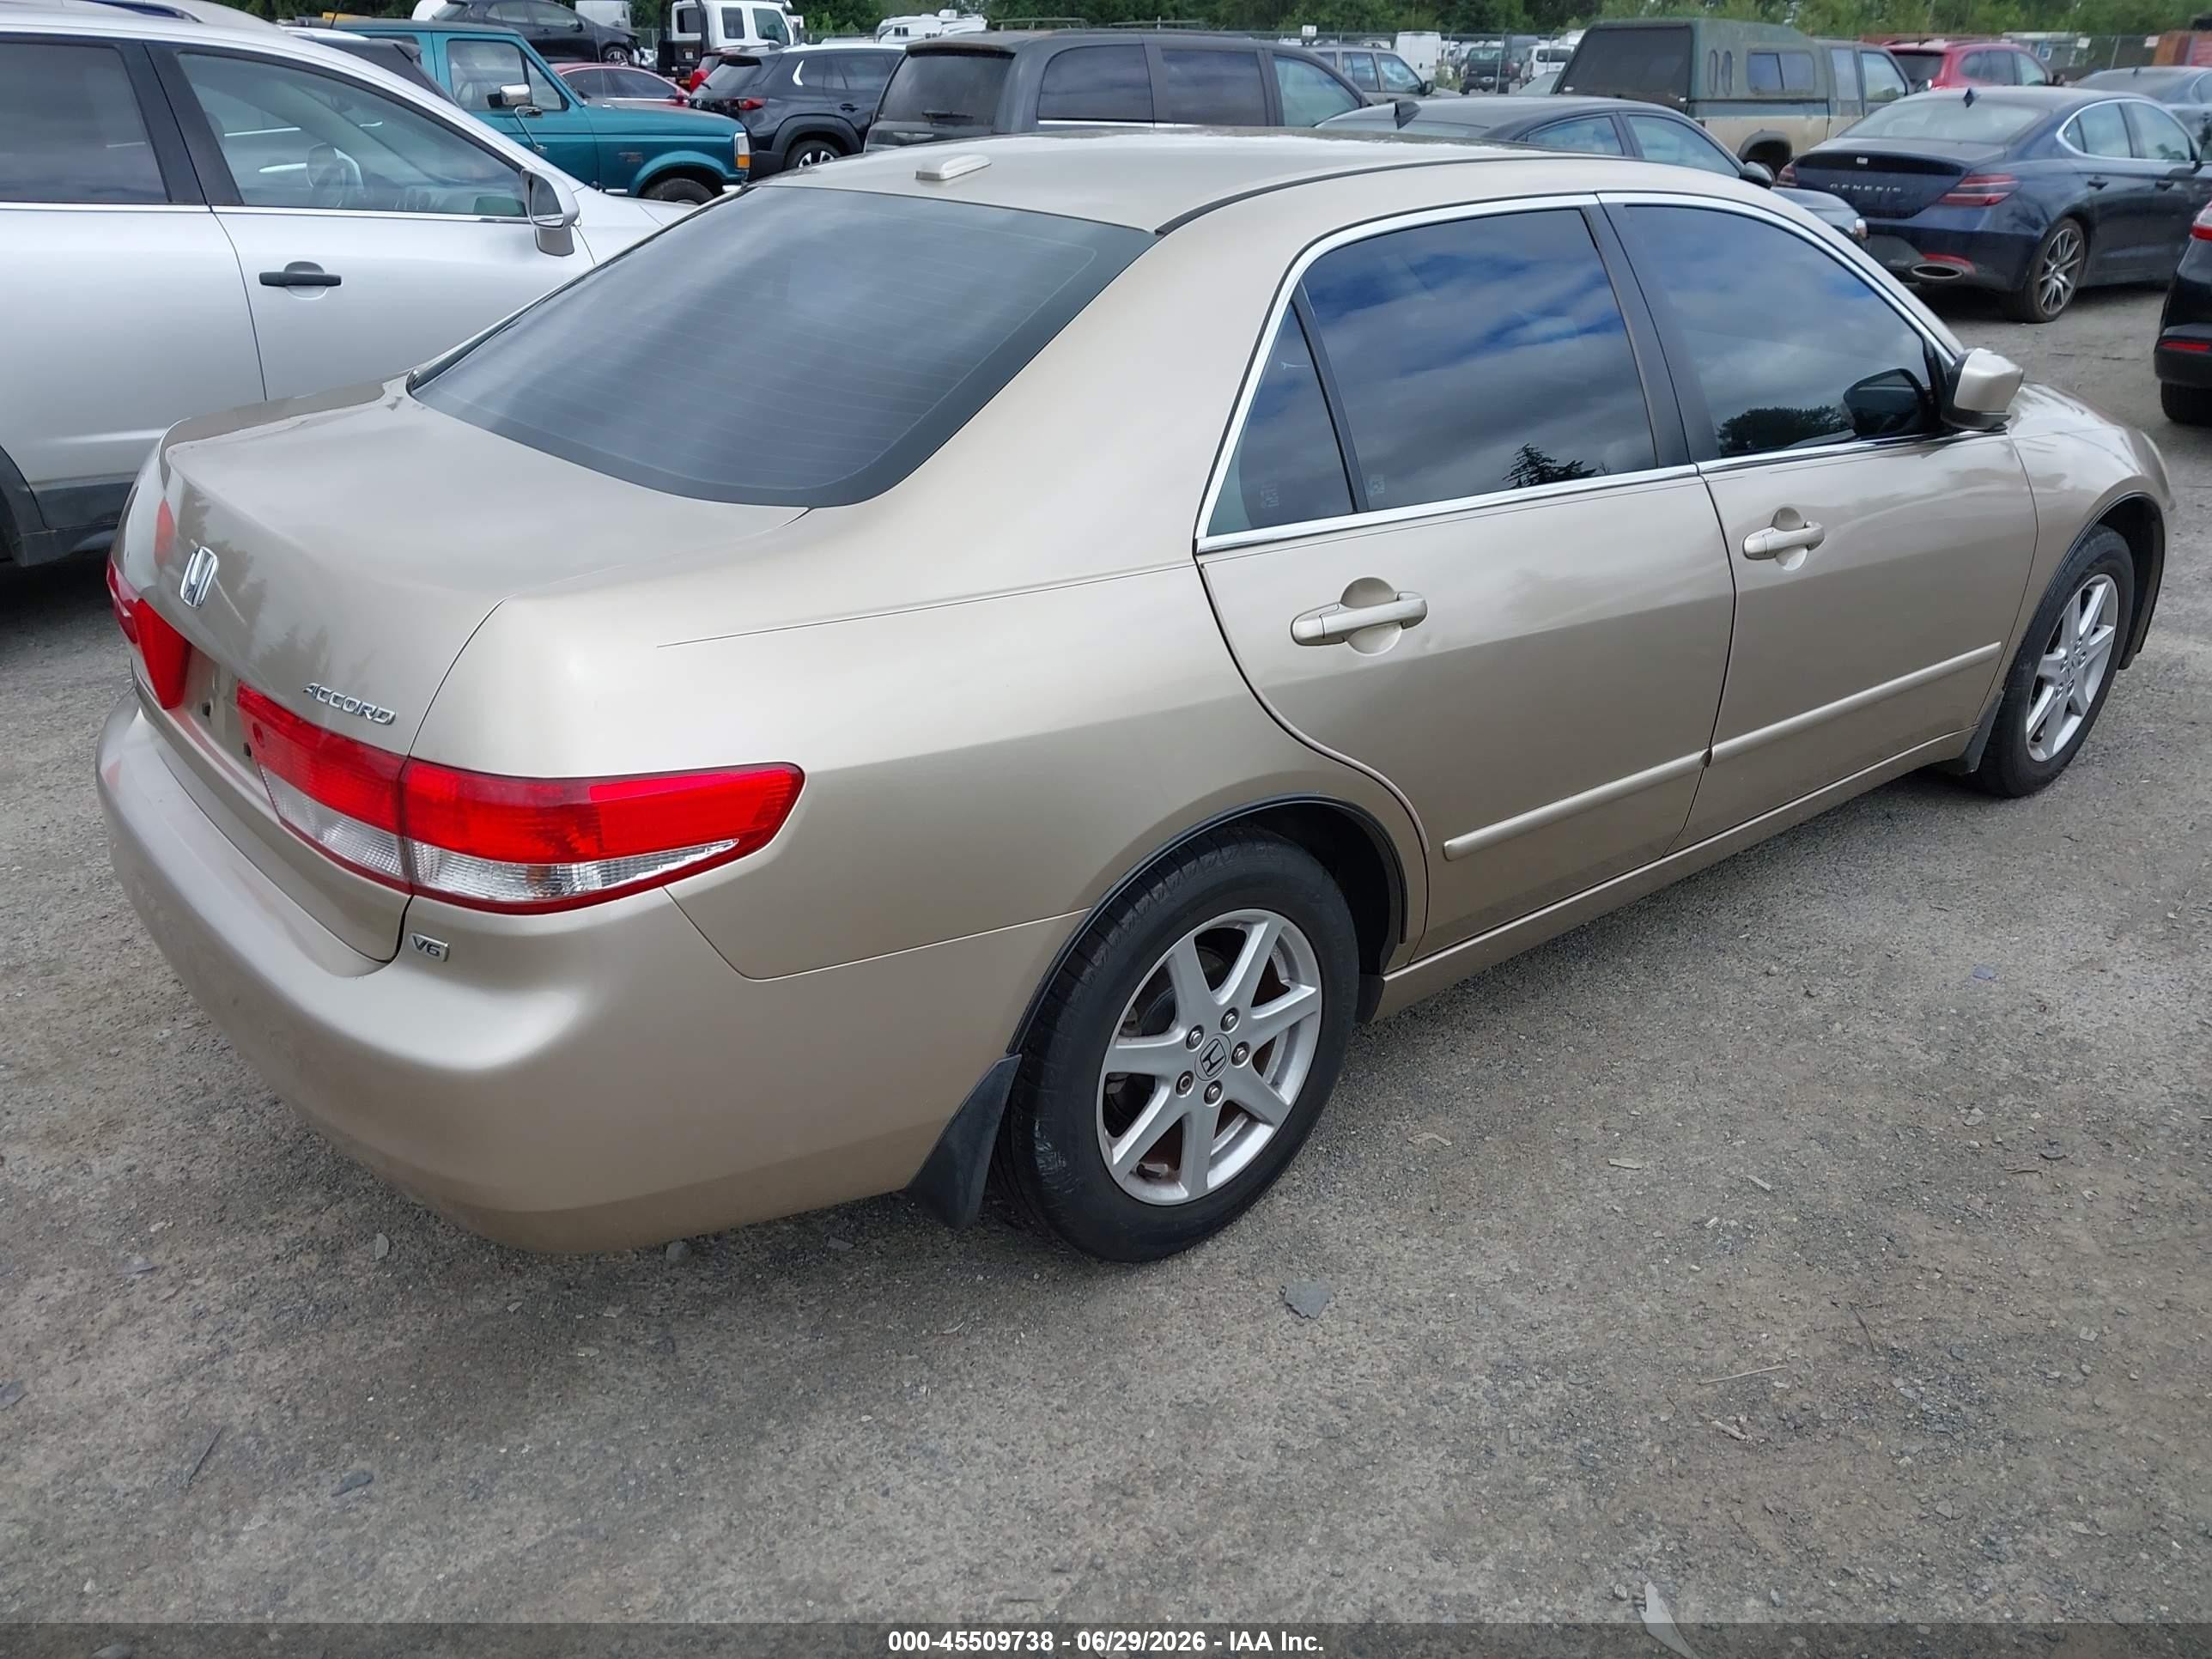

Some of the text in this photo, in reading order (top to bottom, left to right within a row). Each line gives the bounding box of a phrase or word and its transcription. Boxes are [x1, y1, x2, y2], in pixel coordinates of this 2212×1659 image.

[1829, 183, 1901, 192] GENESIS
[302, 682, 396, 726] ACCORD
[411, 933, 441, 957] V6
